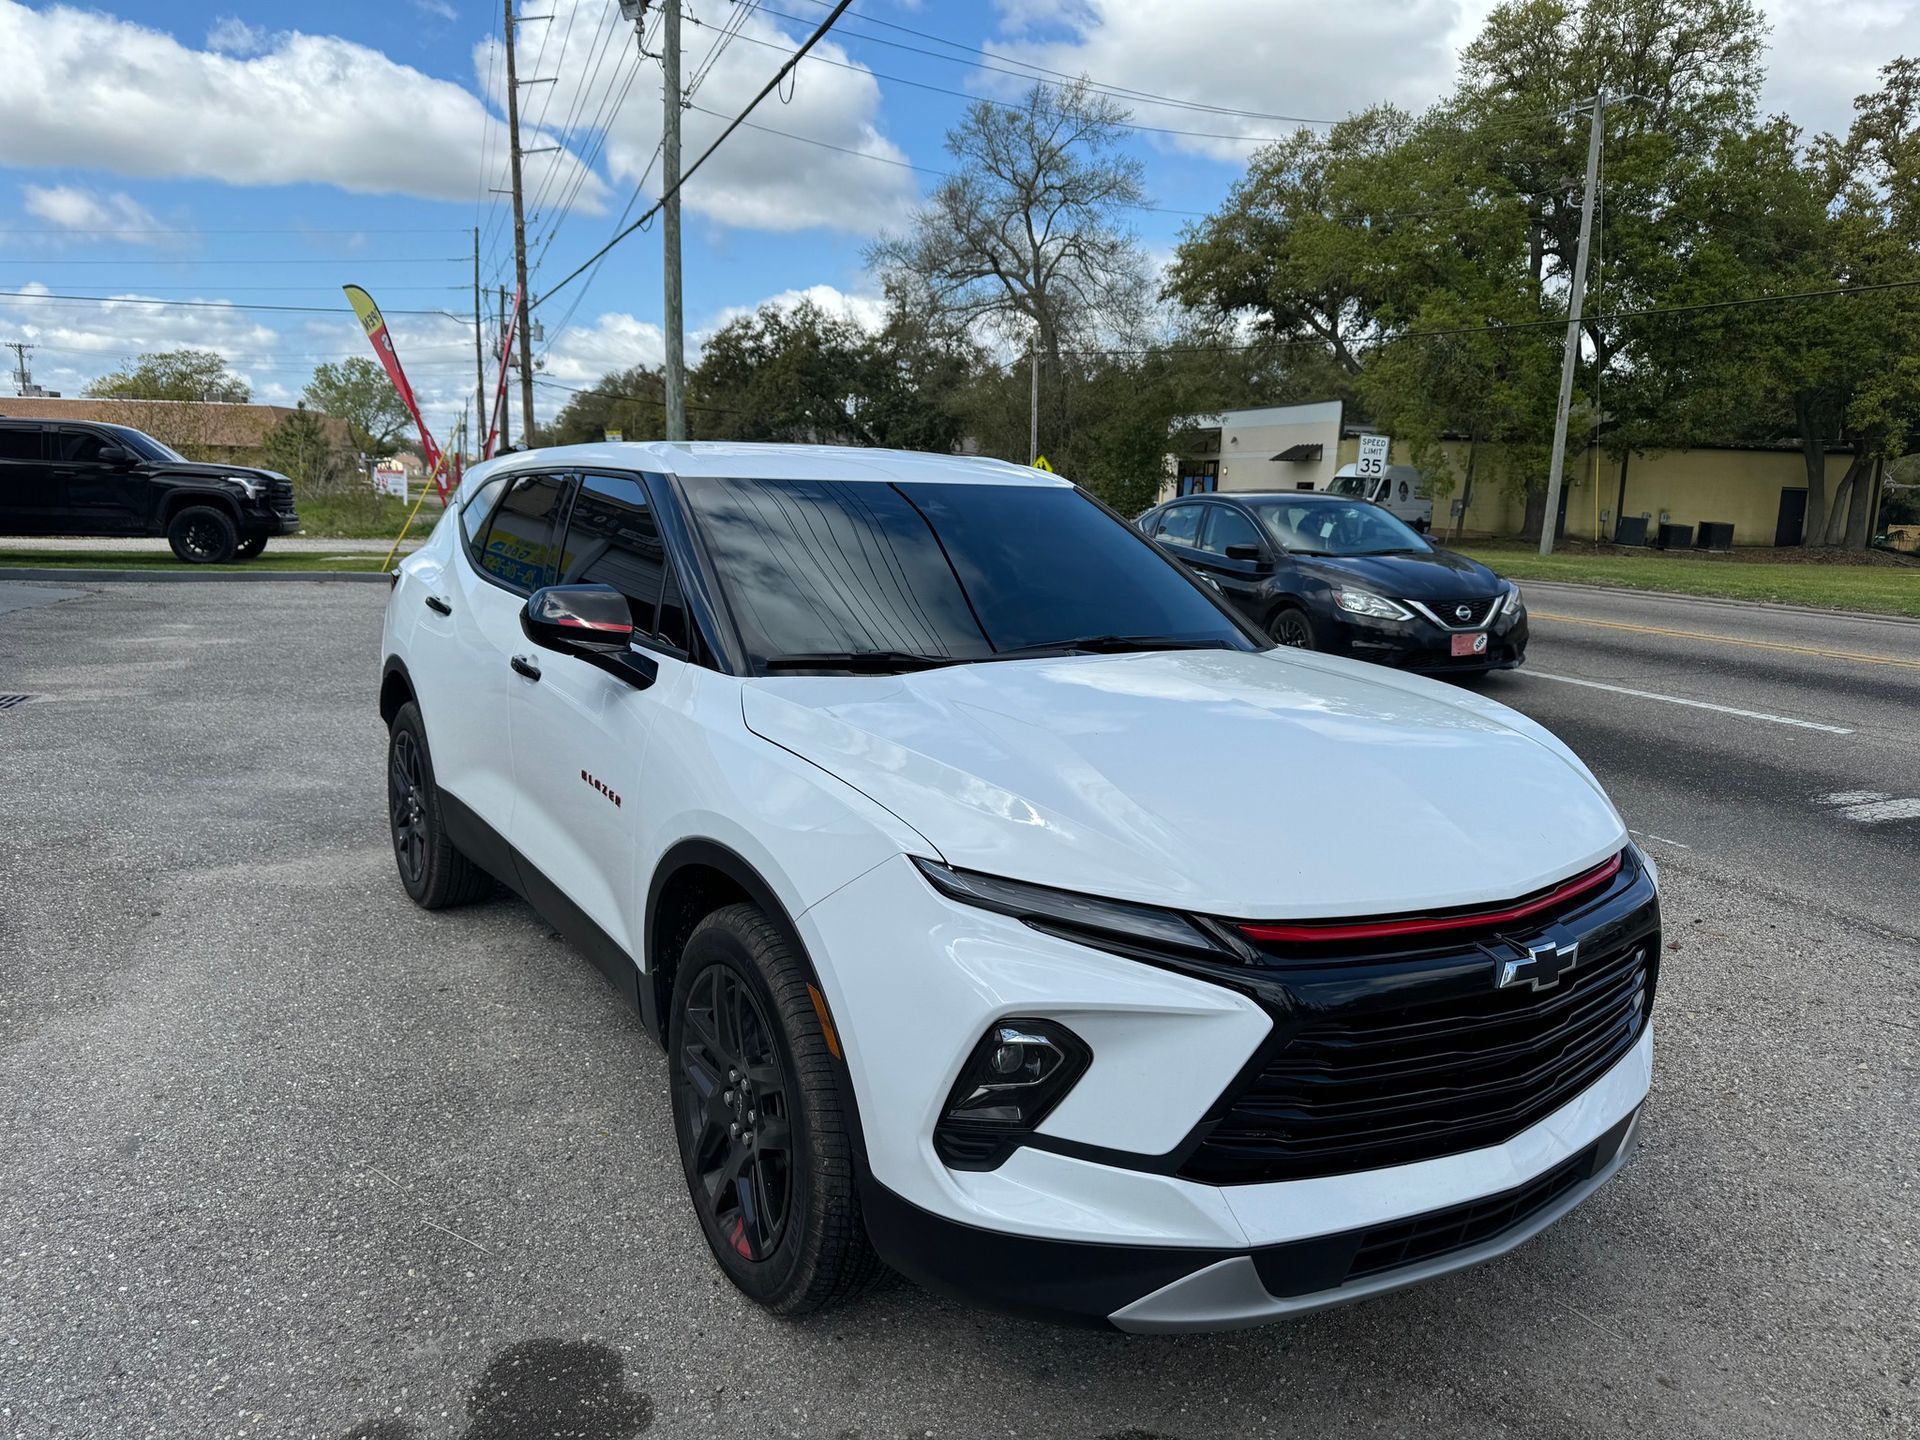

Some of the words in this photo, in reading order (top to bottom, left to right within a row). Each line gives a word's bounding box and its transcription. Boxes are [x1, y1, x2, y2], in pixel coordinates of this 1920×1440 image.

[1362, 438, 1387, 447] SPEED
[1363, 448, 1383, 456] LIMIT
[1360, 458, 1381, 474] 35
[581, 769, 621, 808] BLAZER
